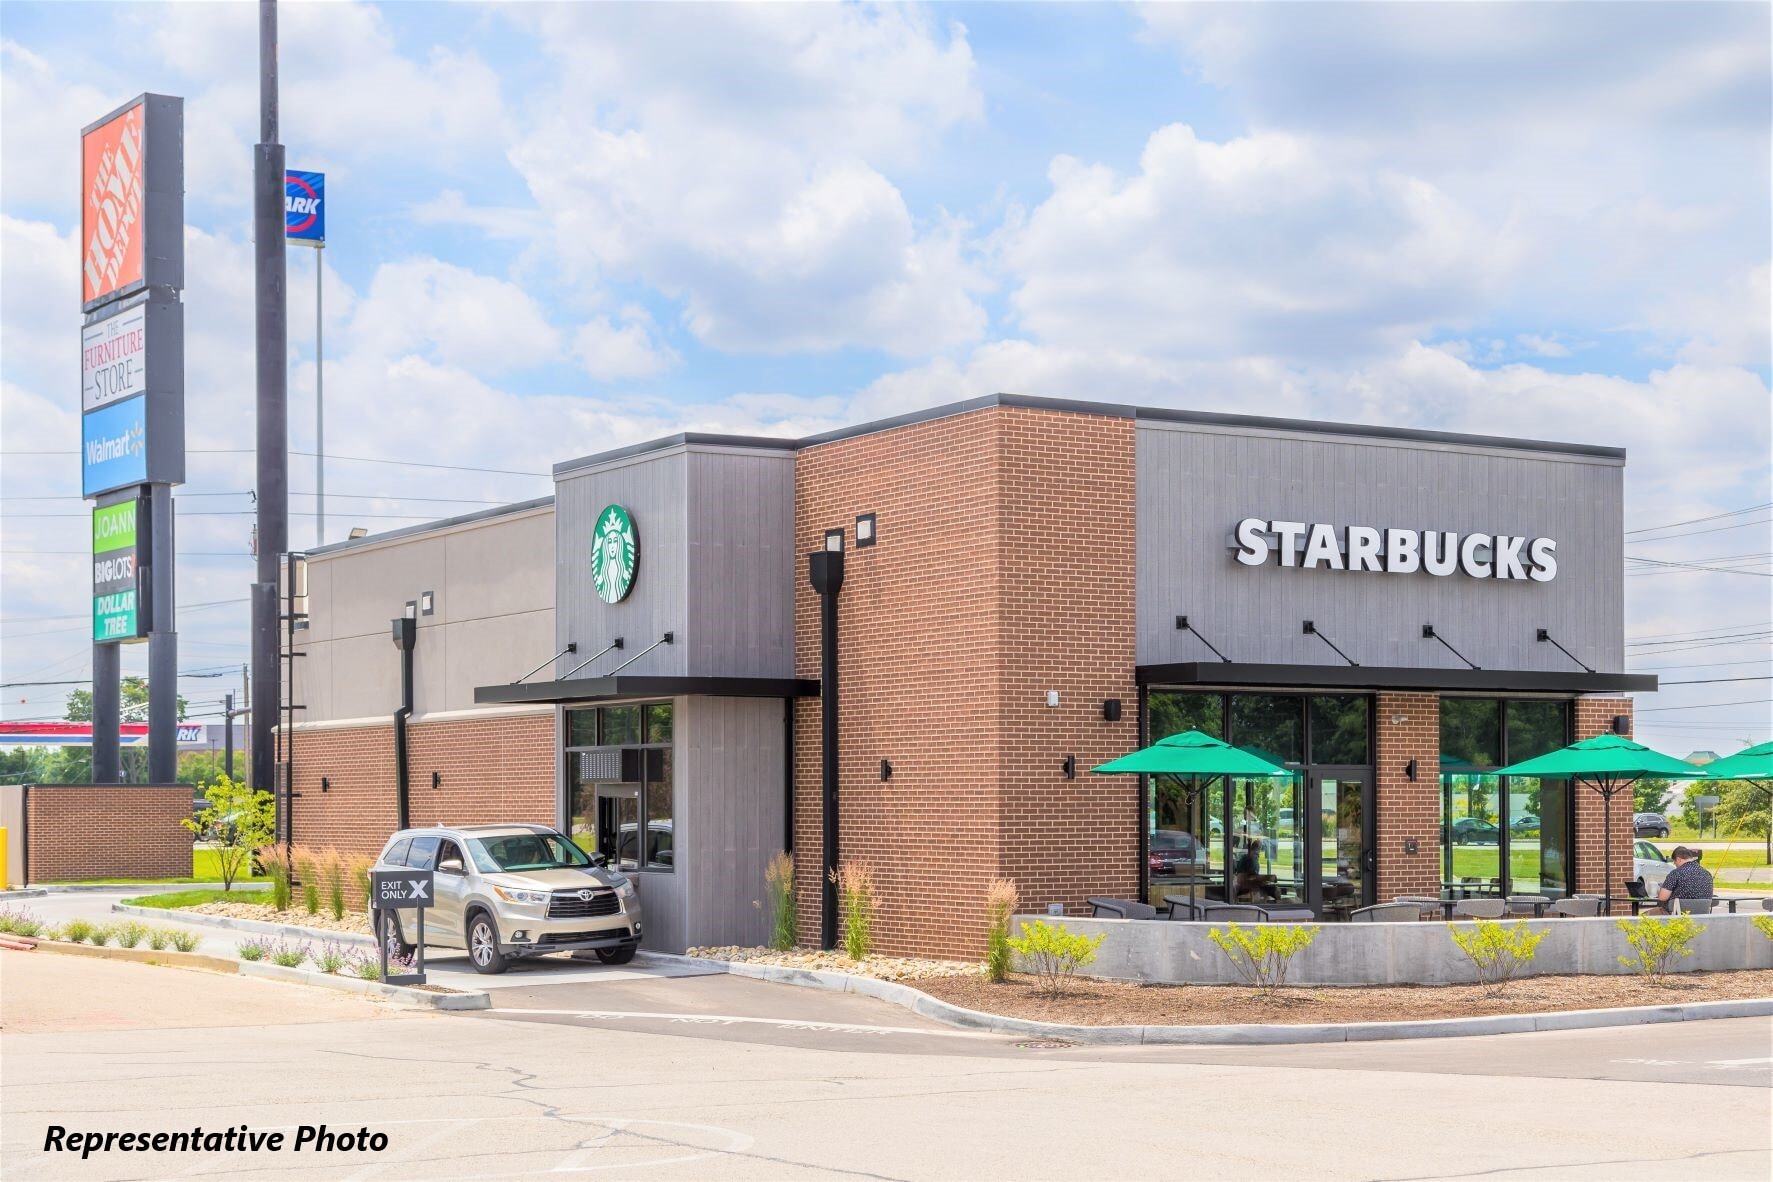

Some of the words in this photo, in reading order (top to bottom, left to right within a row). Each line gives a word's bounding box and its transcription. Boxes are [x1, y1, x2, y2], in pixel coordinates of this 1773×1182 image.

[84, 110, 141, 298] HOME
[285, 196, 320, 215] ARK
[106, 320, 119, 336] THE
[84, 328, 143, 370] FURNITURE
[95, 358, 133, 400] STORE
[86, 429, 131, 465] Walmart
[95, 508, 136, 540] JOANN
[1235, 518, 1558, 582] STARBUCKS
[97, 592, 135, 616] DOLLAR
[104, 615, 128, 637] TREE
[381, 881, 402, 890] EXIT
[381, 890, 407, 899] ONLY
